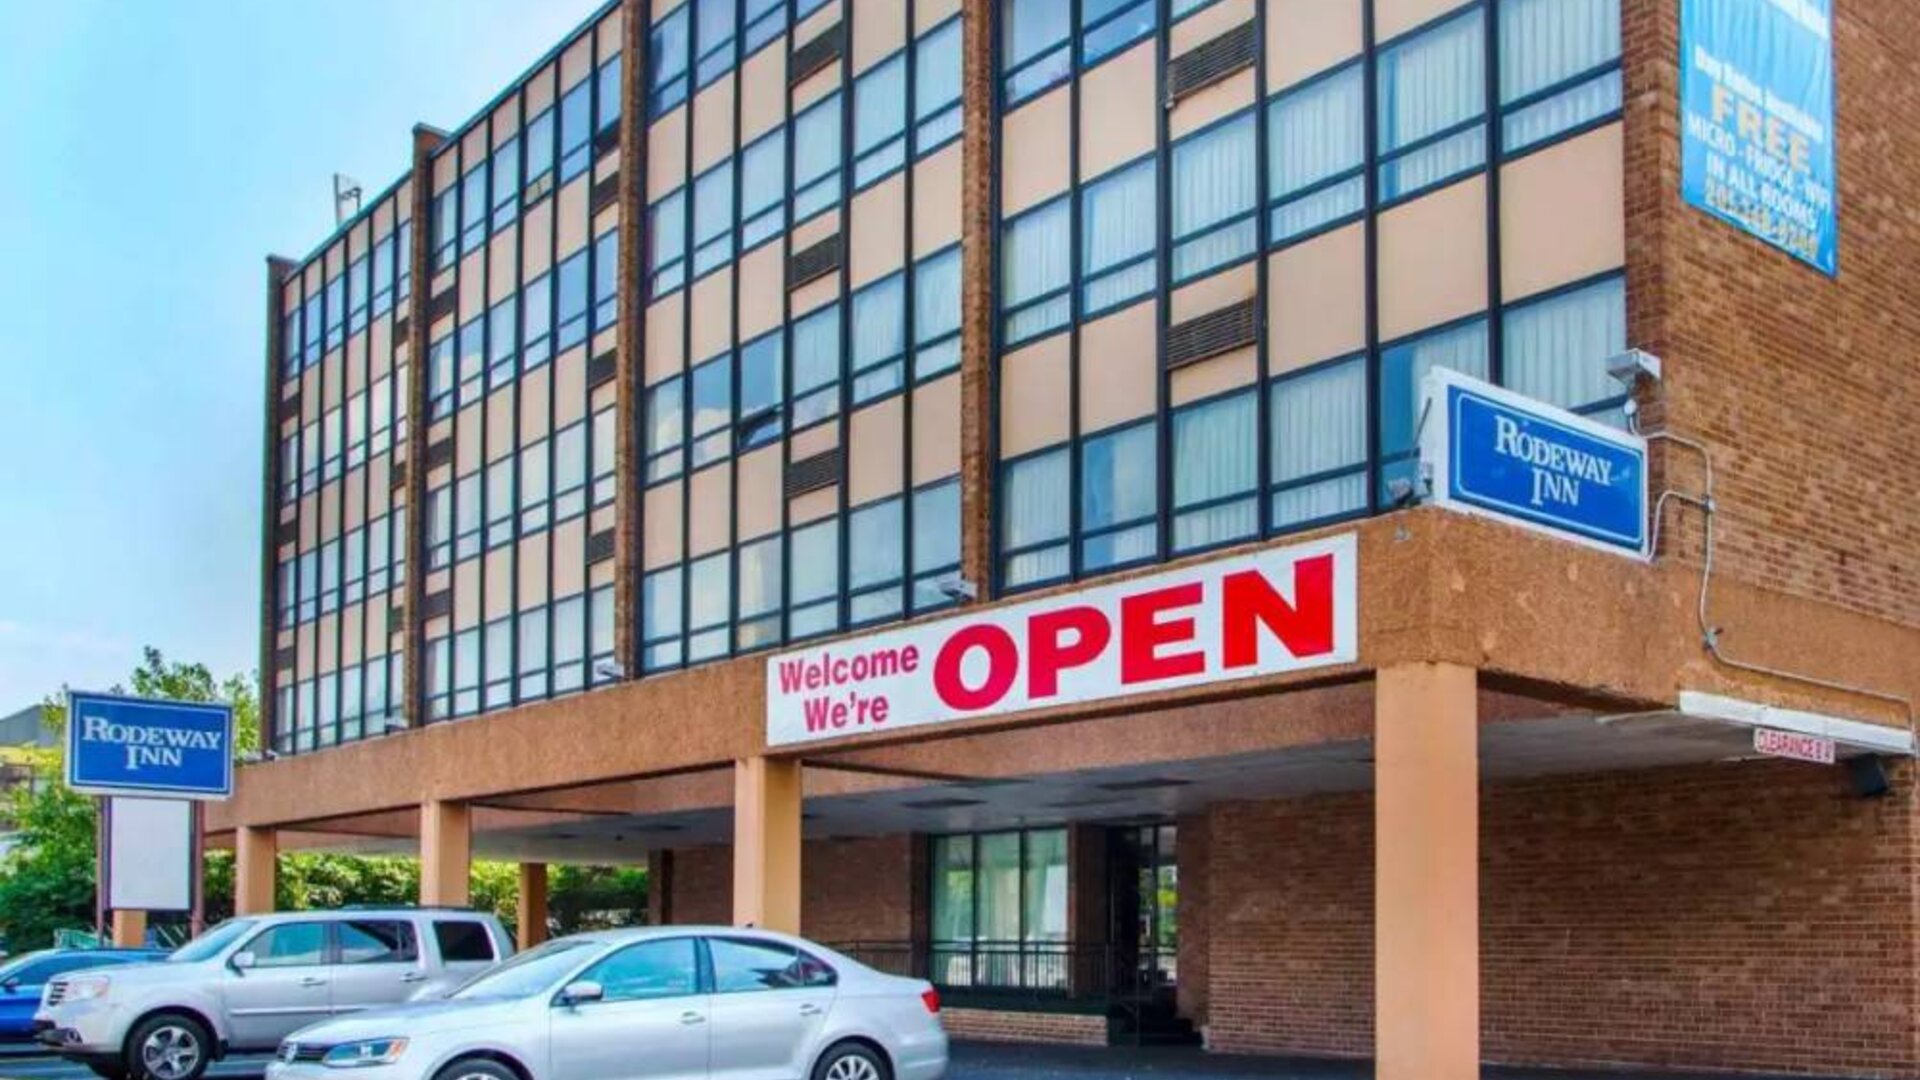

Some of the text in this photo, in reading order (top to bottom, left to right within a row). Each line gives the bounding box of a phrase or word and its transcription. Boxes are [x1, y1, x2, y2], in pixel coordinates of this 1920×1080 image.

[1688, 112, 1736, 157] MICRO
[1711, 83, 1811, 175] FREE
[1706, 150, 1725, 180] IN
[1728, 163, 1758, 199] ALL
[1761, 181, 1817, 230] ROOMS
[1494, 414, 1611, 486] RODEWAY
[1530, 467, 1579, 506] INN
[933, 553, 1334, 712] OPEN
[779, 644, 919, 694] Welcome
[82, 715, 221, 749] RODEWAY
[803, 691, 889, 733] We're
[126, 745, 182, 770] INN
[1757, 730, 1813, 758] CLEARANCE
